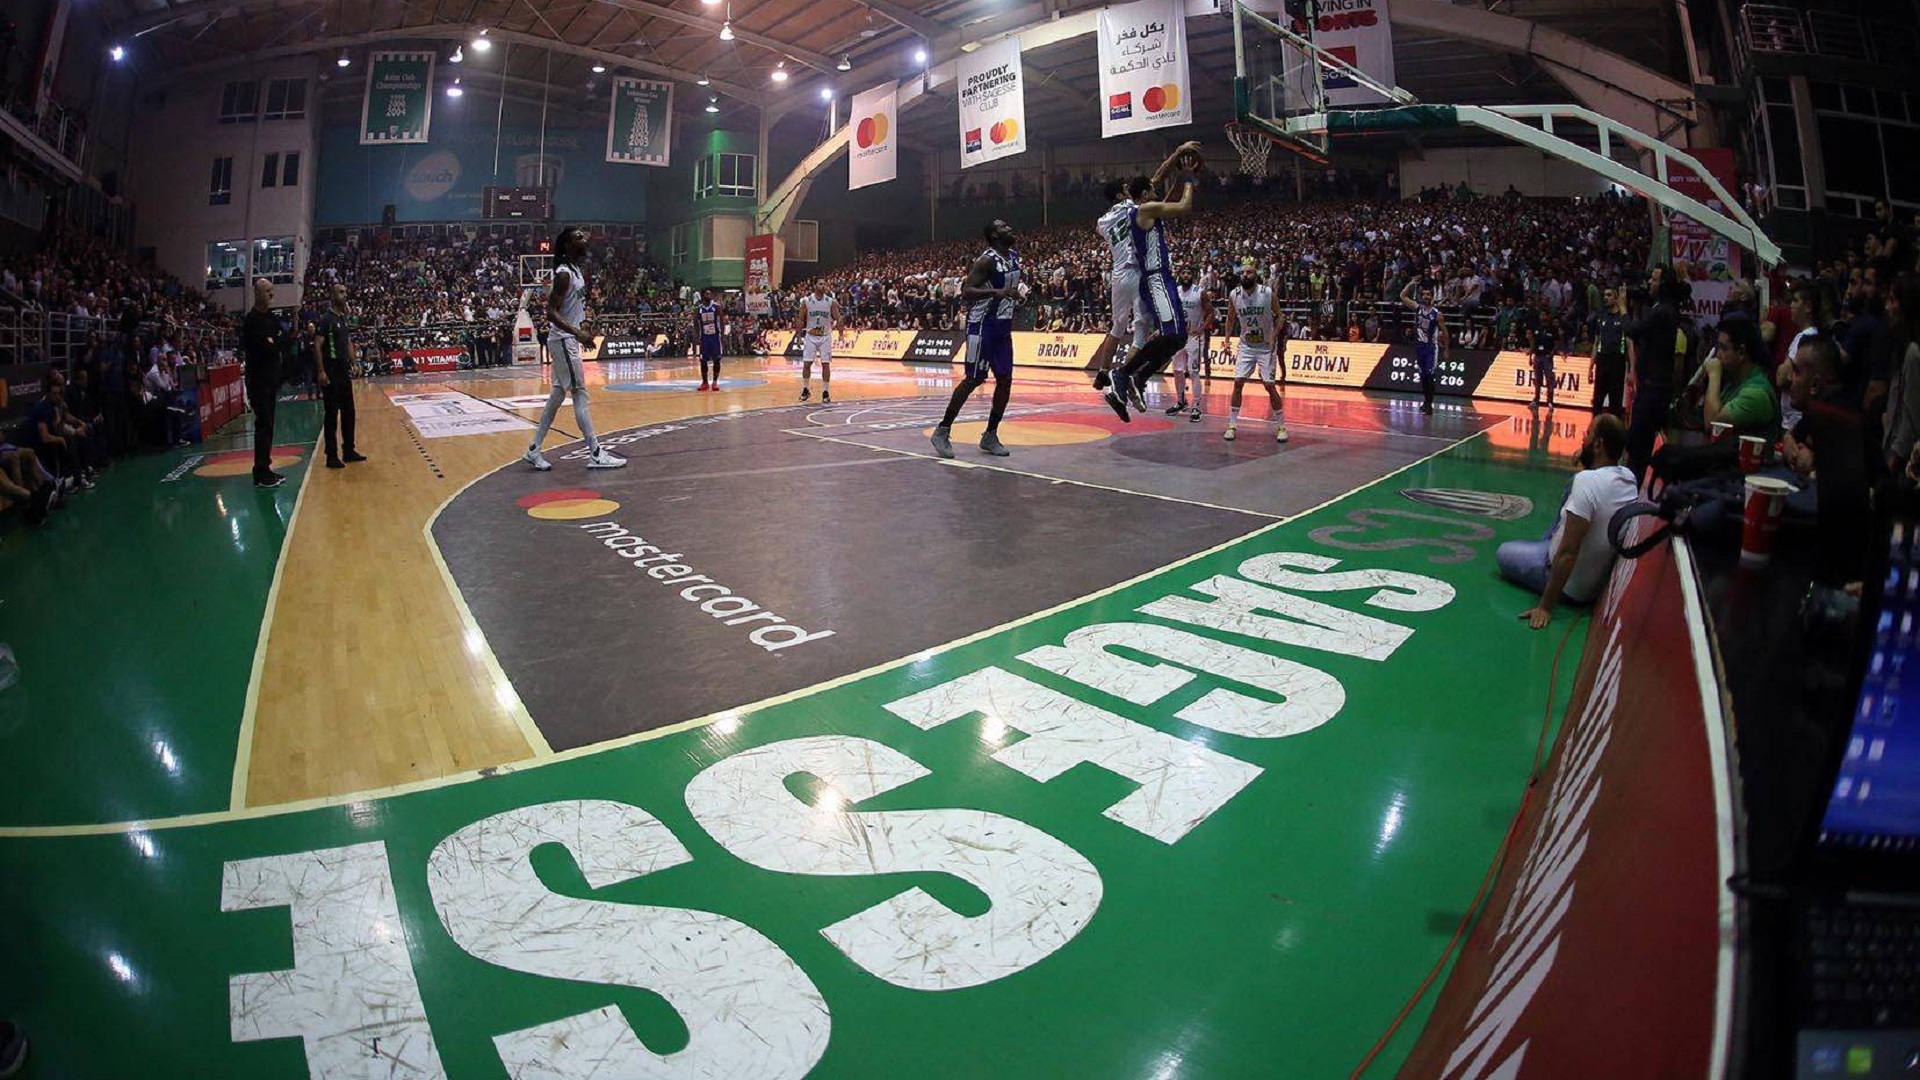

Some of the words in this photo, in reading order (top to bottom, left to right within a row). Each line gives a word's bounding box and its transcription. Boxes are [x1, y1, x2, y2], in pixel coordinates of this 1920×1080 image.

[1116, 27, 1137, 45] فخر
[1140, 22, 1164, 38] بكل
[1122, 38, 1161, 55] شركاء
[1110, 57, 1149, 76] الحكمة
[968, 64, 1008, 86] PROUDLY
[962, 72, 1016, 98] PARTNERING
[962, 94, 982, 107] WITH
[982, 82, 1016, 101] SAGESSE
[980, 98, 999, 112] CLUB
[628, 137, 649, 147] 2003
[1246, 317, 1259, 327] 24
[872, 340, 899, 351] BROWN
[1038, 343, 1079, 358] BROWN
[1315, 345, 1329, 354] MR
[1292, 355, 1350, 373] BROWN
[1450, 363, 1465, 372] 94
[1441, 376, 1465, 386] 206
[579, 521, 837, 652] mastercard
[222, 551, 1456, 1080] SAGESSE
